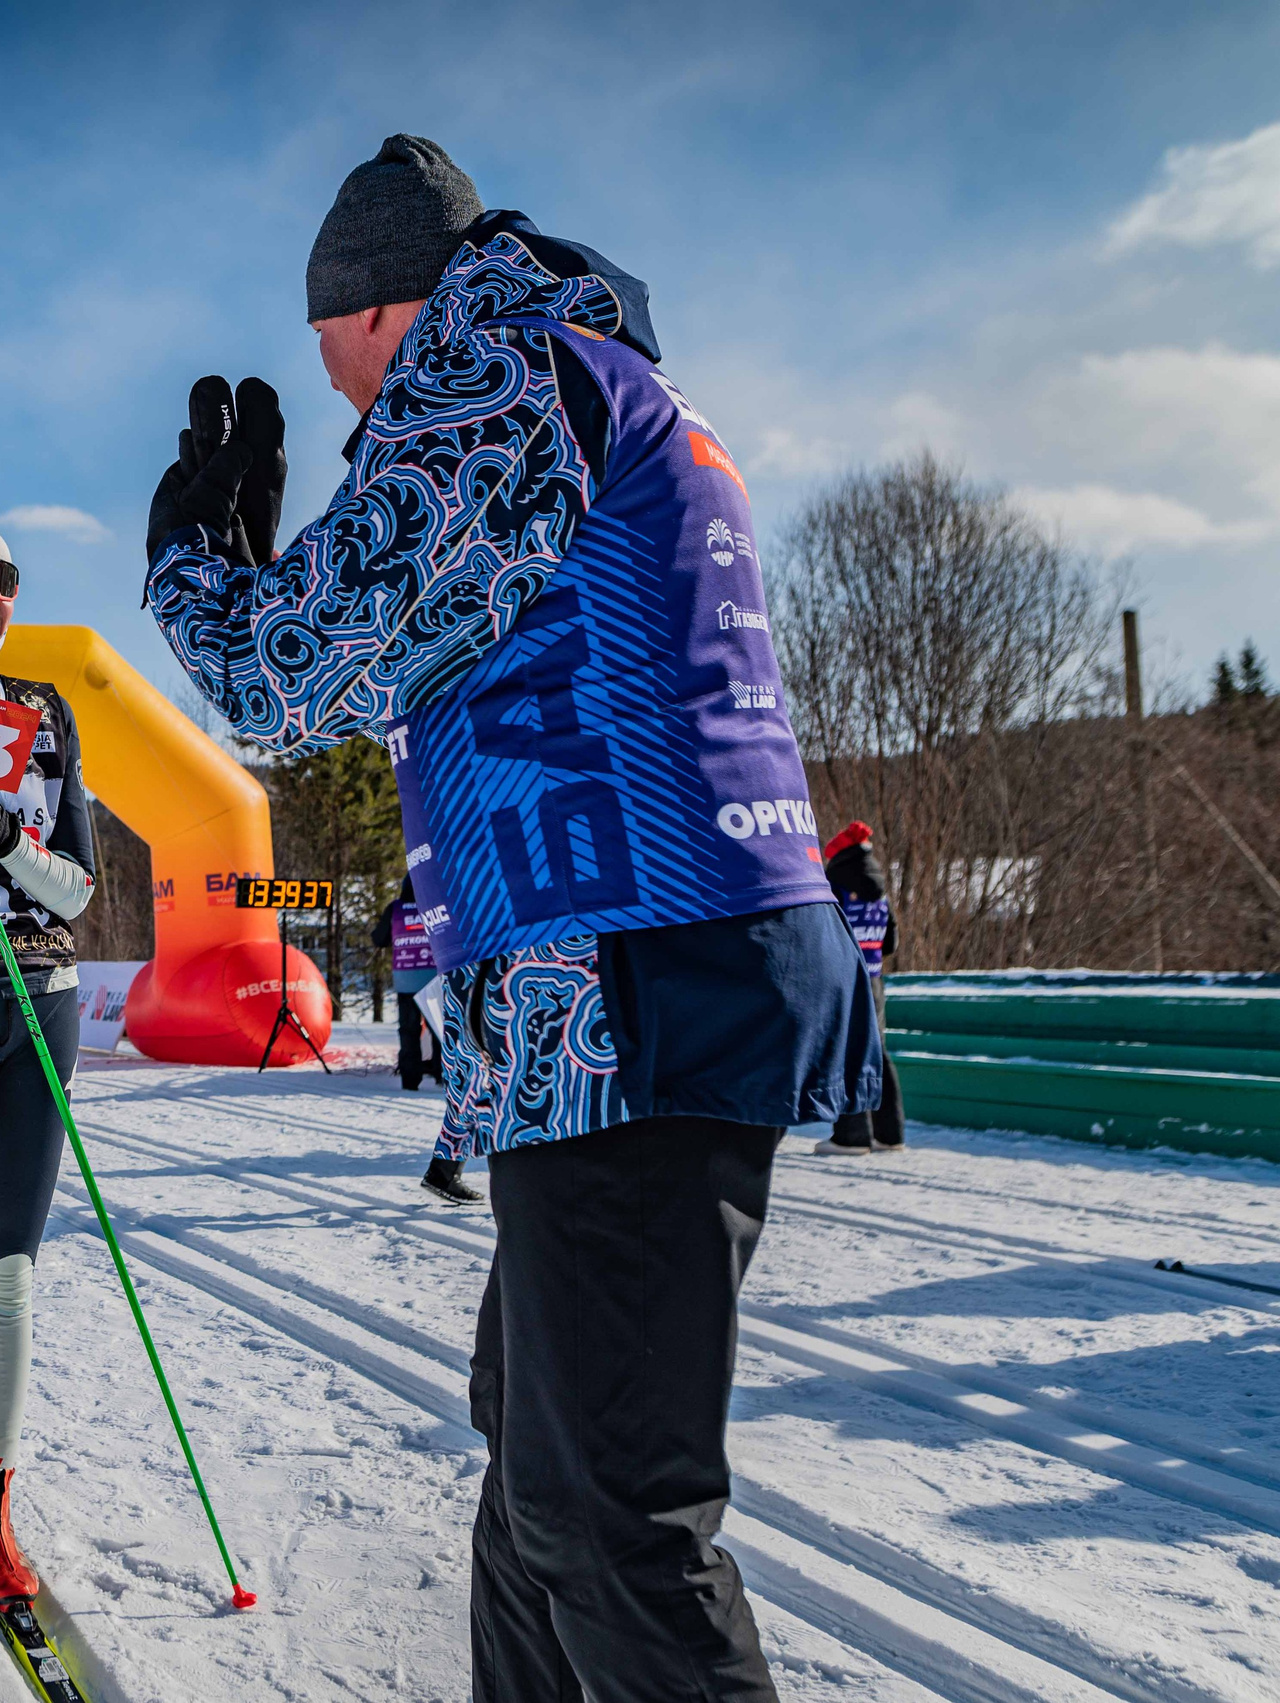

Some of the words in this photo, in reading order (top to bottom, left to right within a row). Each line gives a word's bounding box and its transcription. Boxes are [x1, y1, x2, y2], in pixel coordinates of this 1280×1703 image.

[751, 685, 776, 695] KRAS
[751, 695, 776, 709] LAND
[17, 993, 41, 1042] KV+
